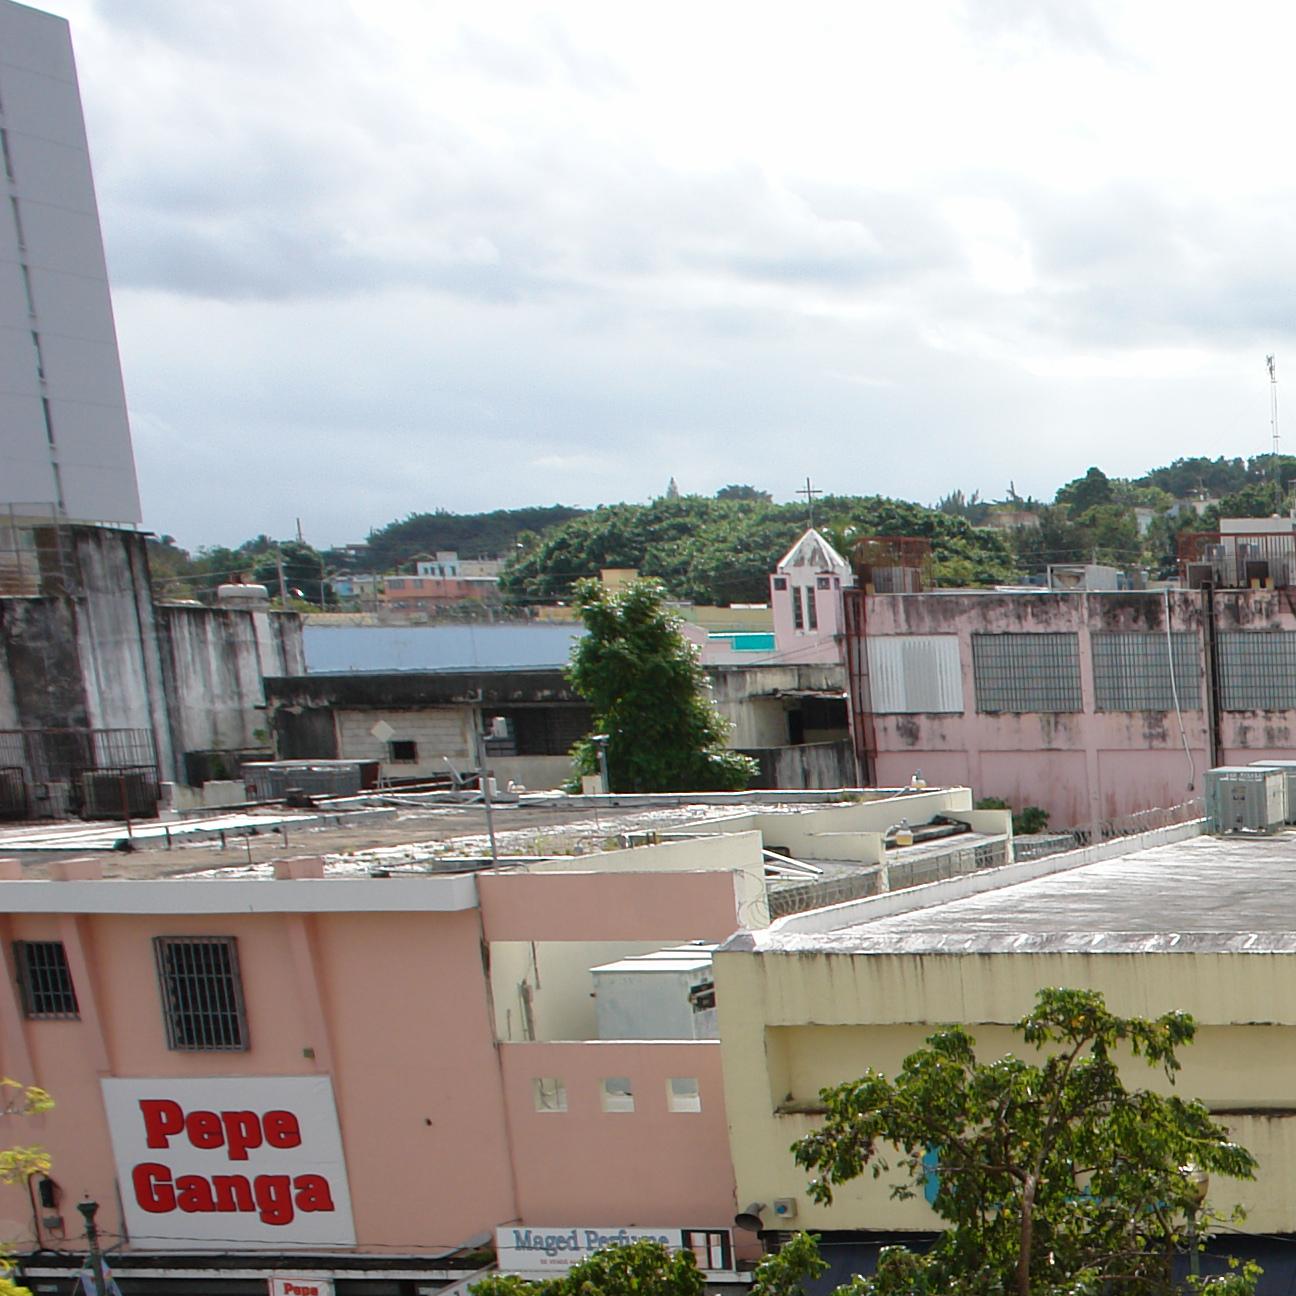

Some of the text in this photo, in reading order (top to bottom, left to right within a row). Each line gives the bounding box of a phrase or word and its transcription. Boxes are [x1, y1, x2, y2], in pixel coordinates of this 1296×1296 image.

[138, 1098, 302, 1161] Pepe
[131, 1162, 335, 1226] Ganga
[513, 1229, 580, 1256] Maged
